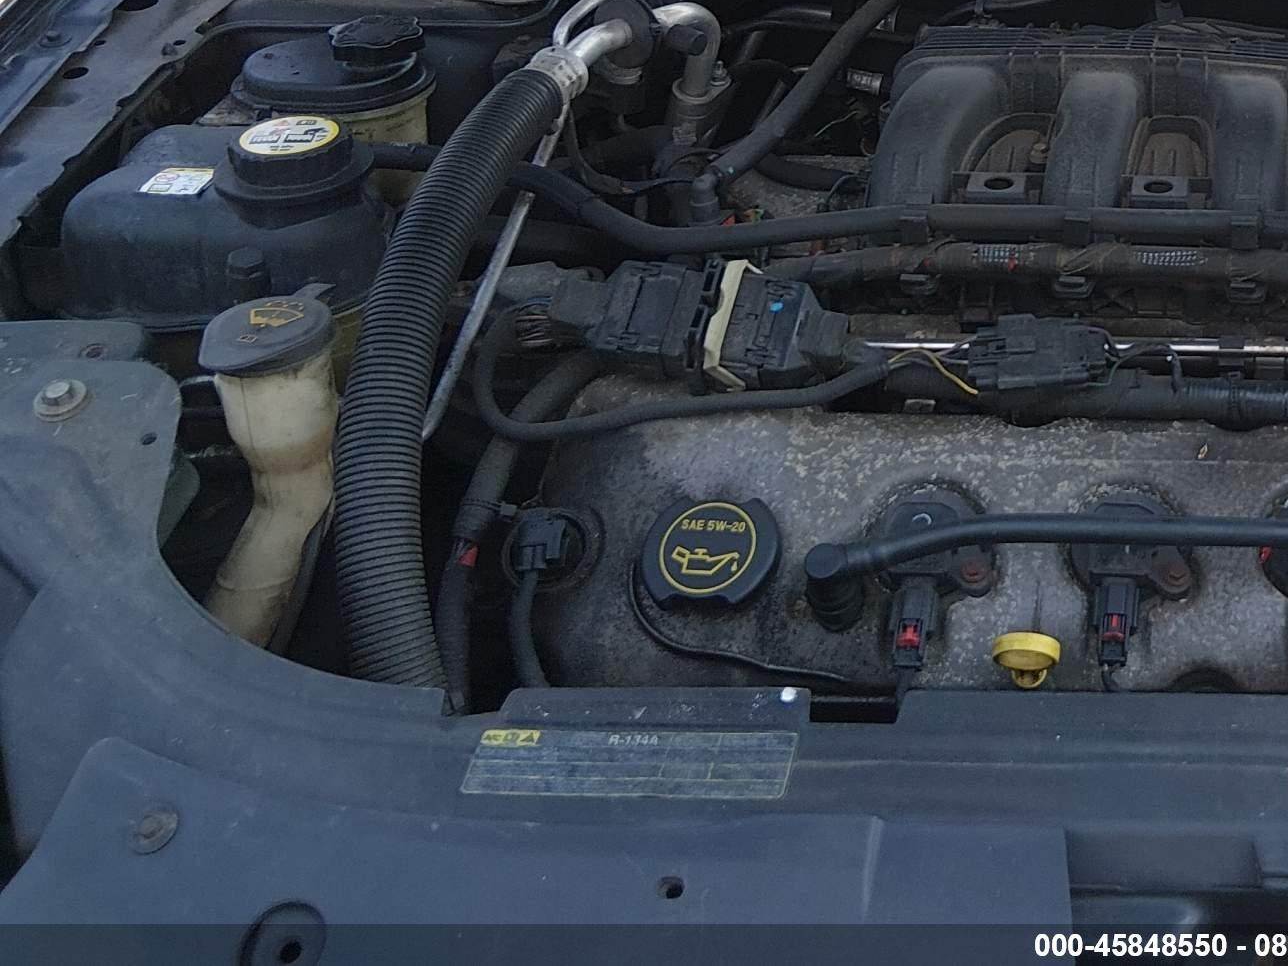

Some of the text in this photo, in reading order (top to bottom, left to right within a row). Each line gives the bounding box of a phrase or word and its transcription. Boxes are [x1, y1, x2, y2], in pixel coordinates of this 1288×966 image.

[681, 518, 746, 533] SAE 5W-20
[608, 734, 659, 746] R-134A
